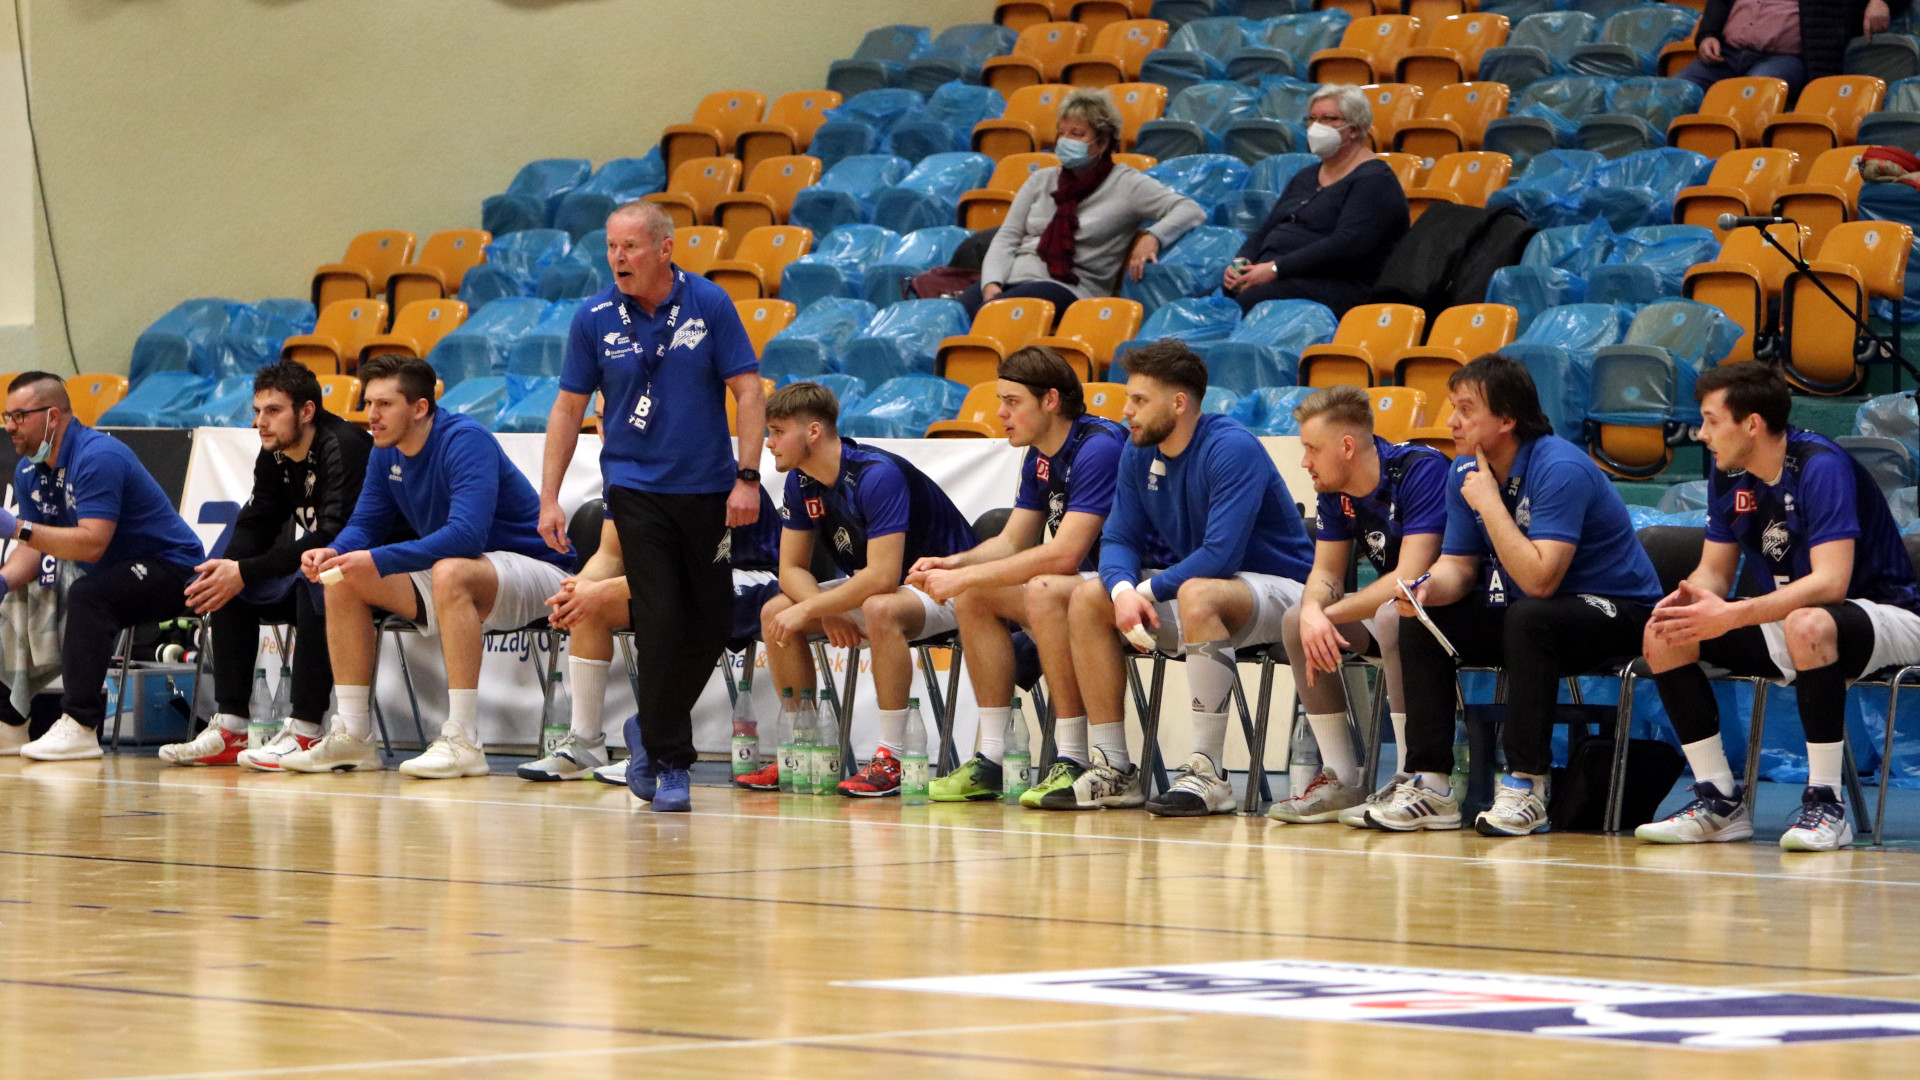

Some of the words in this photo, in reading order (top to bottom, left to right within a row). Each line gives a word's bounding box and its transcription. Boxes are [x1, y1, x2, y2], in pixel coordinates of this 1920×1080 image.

[666, 304, 681, 328] 2.HBL
[634, 395, 652, 417] B
[42, 554, 56, 574] C
[1489, 570, 1504, 591] A
